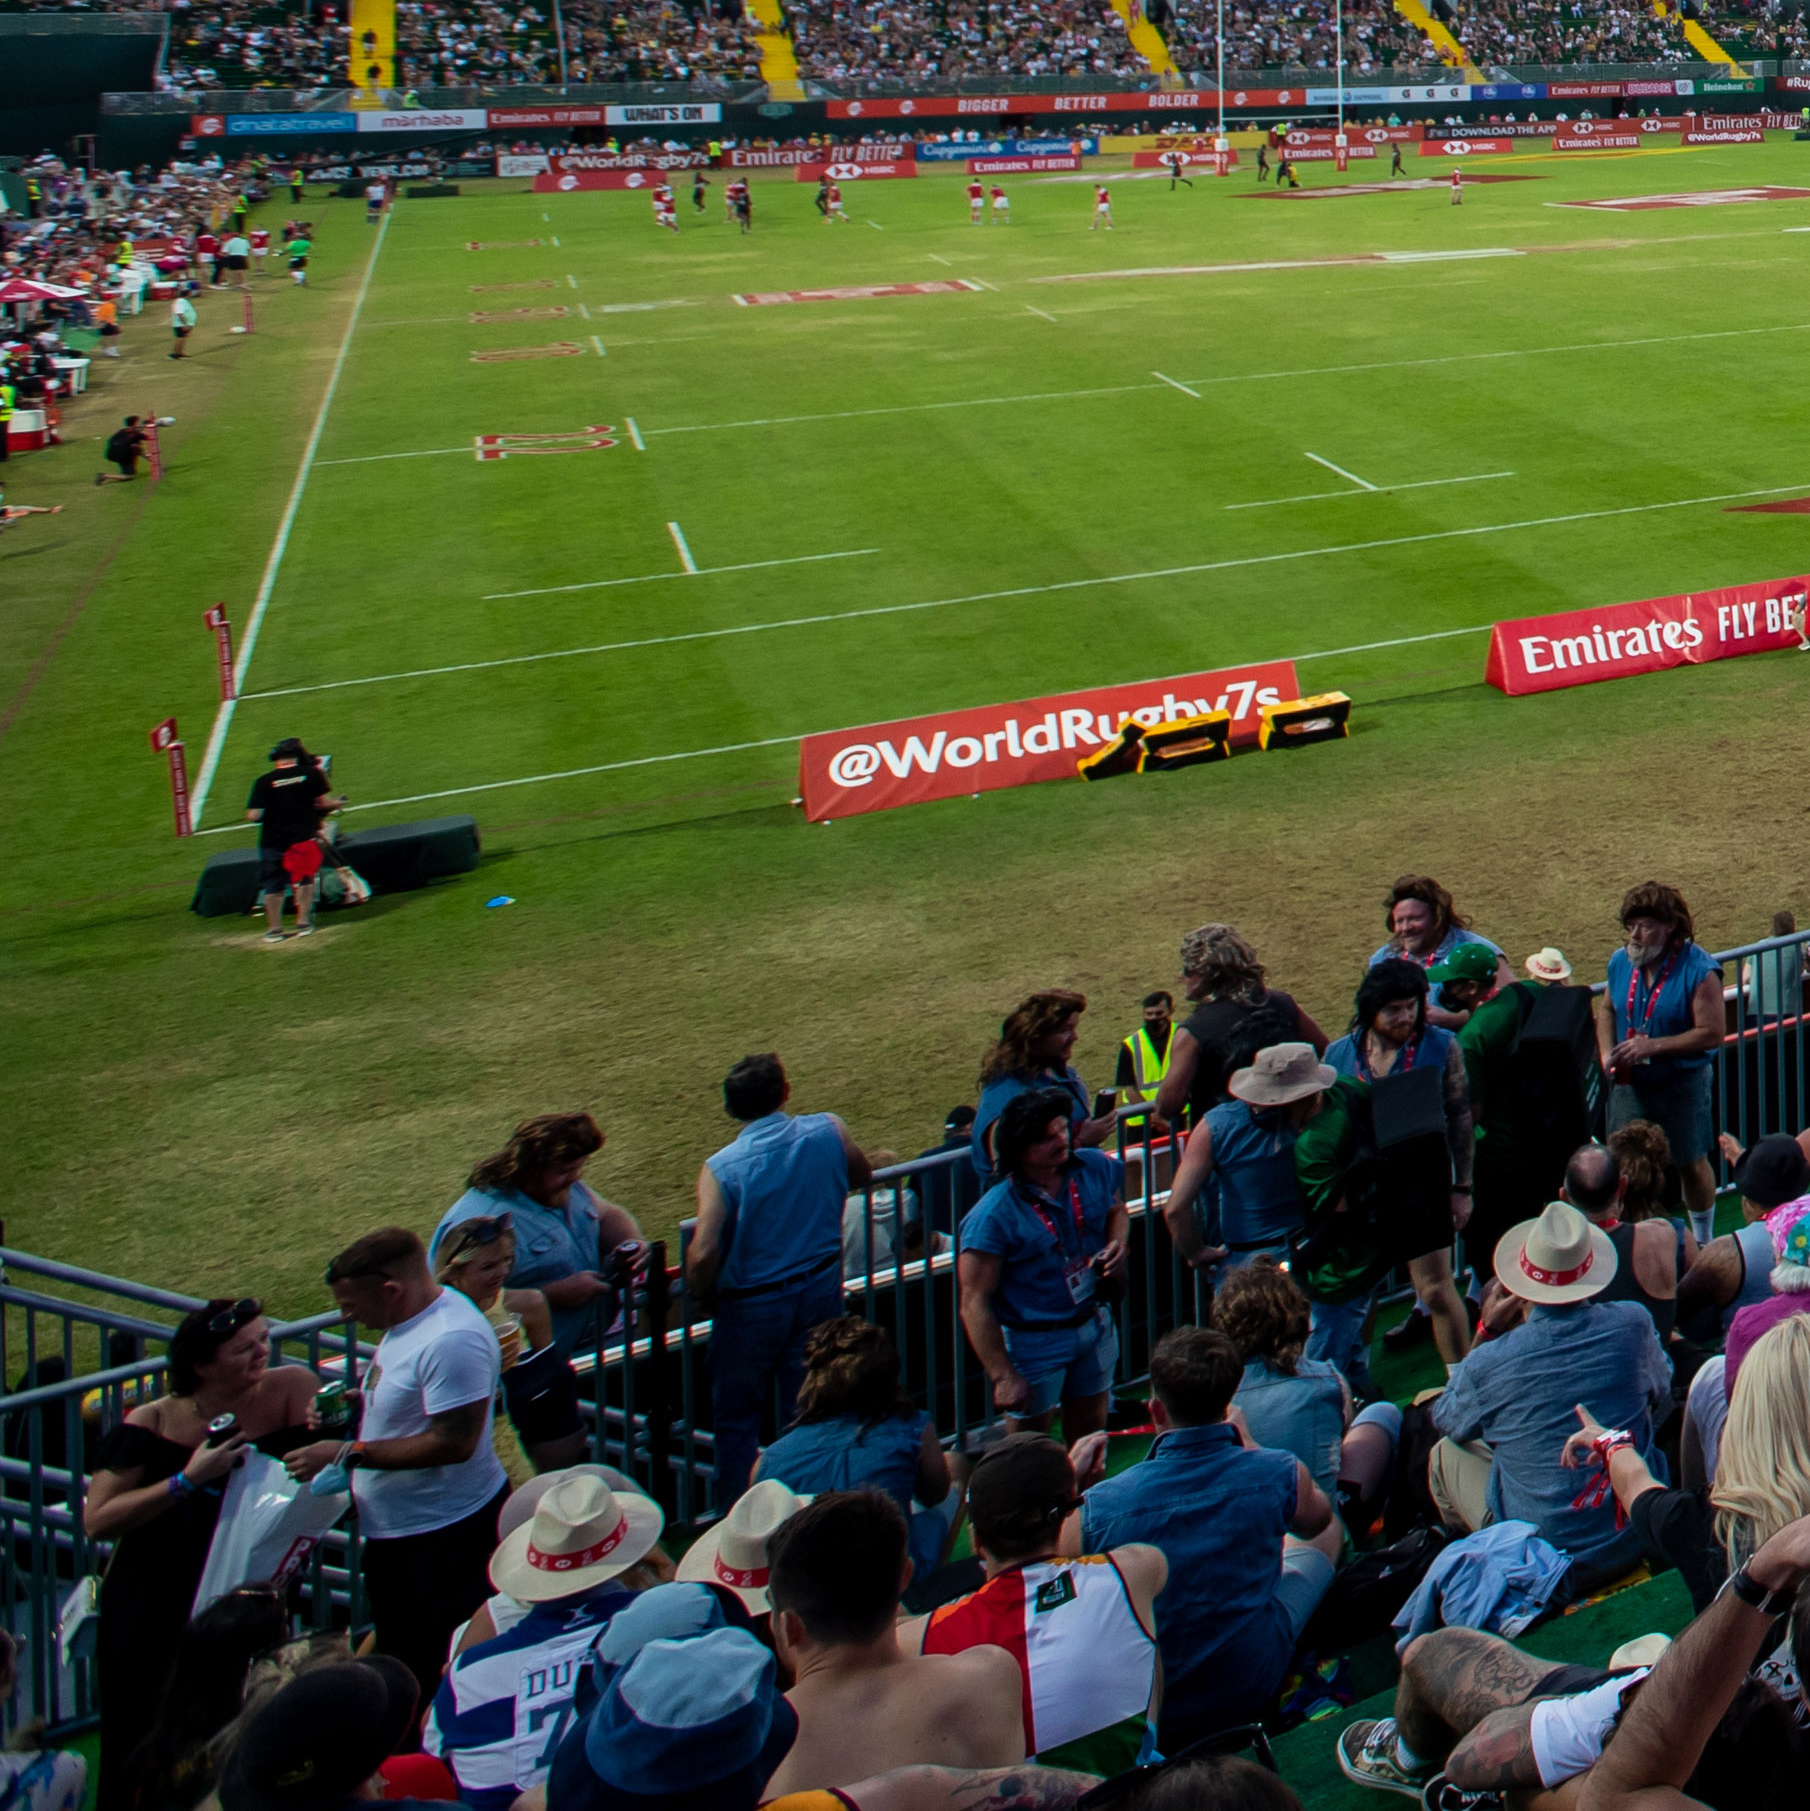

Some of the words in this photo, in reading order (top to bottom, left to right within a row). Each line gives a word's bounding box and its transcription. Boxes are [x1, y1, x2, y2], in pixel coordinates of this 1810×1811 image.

[1552, 85, 1589, 96] Emirates
[1704, 81, 1743, 91] Heineken
[958, 99, 1009, 113] BIGGER
[1054, 96, 1107, 110] BETTER
[1148, 93, 1199, 107] BOLDER
[382, 112, 465, 129] marhaba
[491, 111, 550, 124] Emirates
[553, 110, 569, 123] FLY
[570, 109, 601, 122] BETTER
[624, 107, 680, 121] WHAT'S
[682, 106, 703, 120] ON
[1704, 117, 1762, 130] Emirates
[1767, 114, 1783, 128] FLY
[1452, 126, 1515, 139] DOWNLOAD
[1517, 125, 1534, 136] THE
[1537, 125, 1557, 135] APP
[1687, 130, 1761, 143] @WorldRugby7s
[923, 144, 989, 158] Capgemini
[974, 160, 1029, 173] Emirates
[1032, 158, 1047, 169] FLY
[1048, 157, 1075, 169] BETTER
[1518, 617, 1702, 675] Emirates
[1718, 603, 1756, 641] FLY
